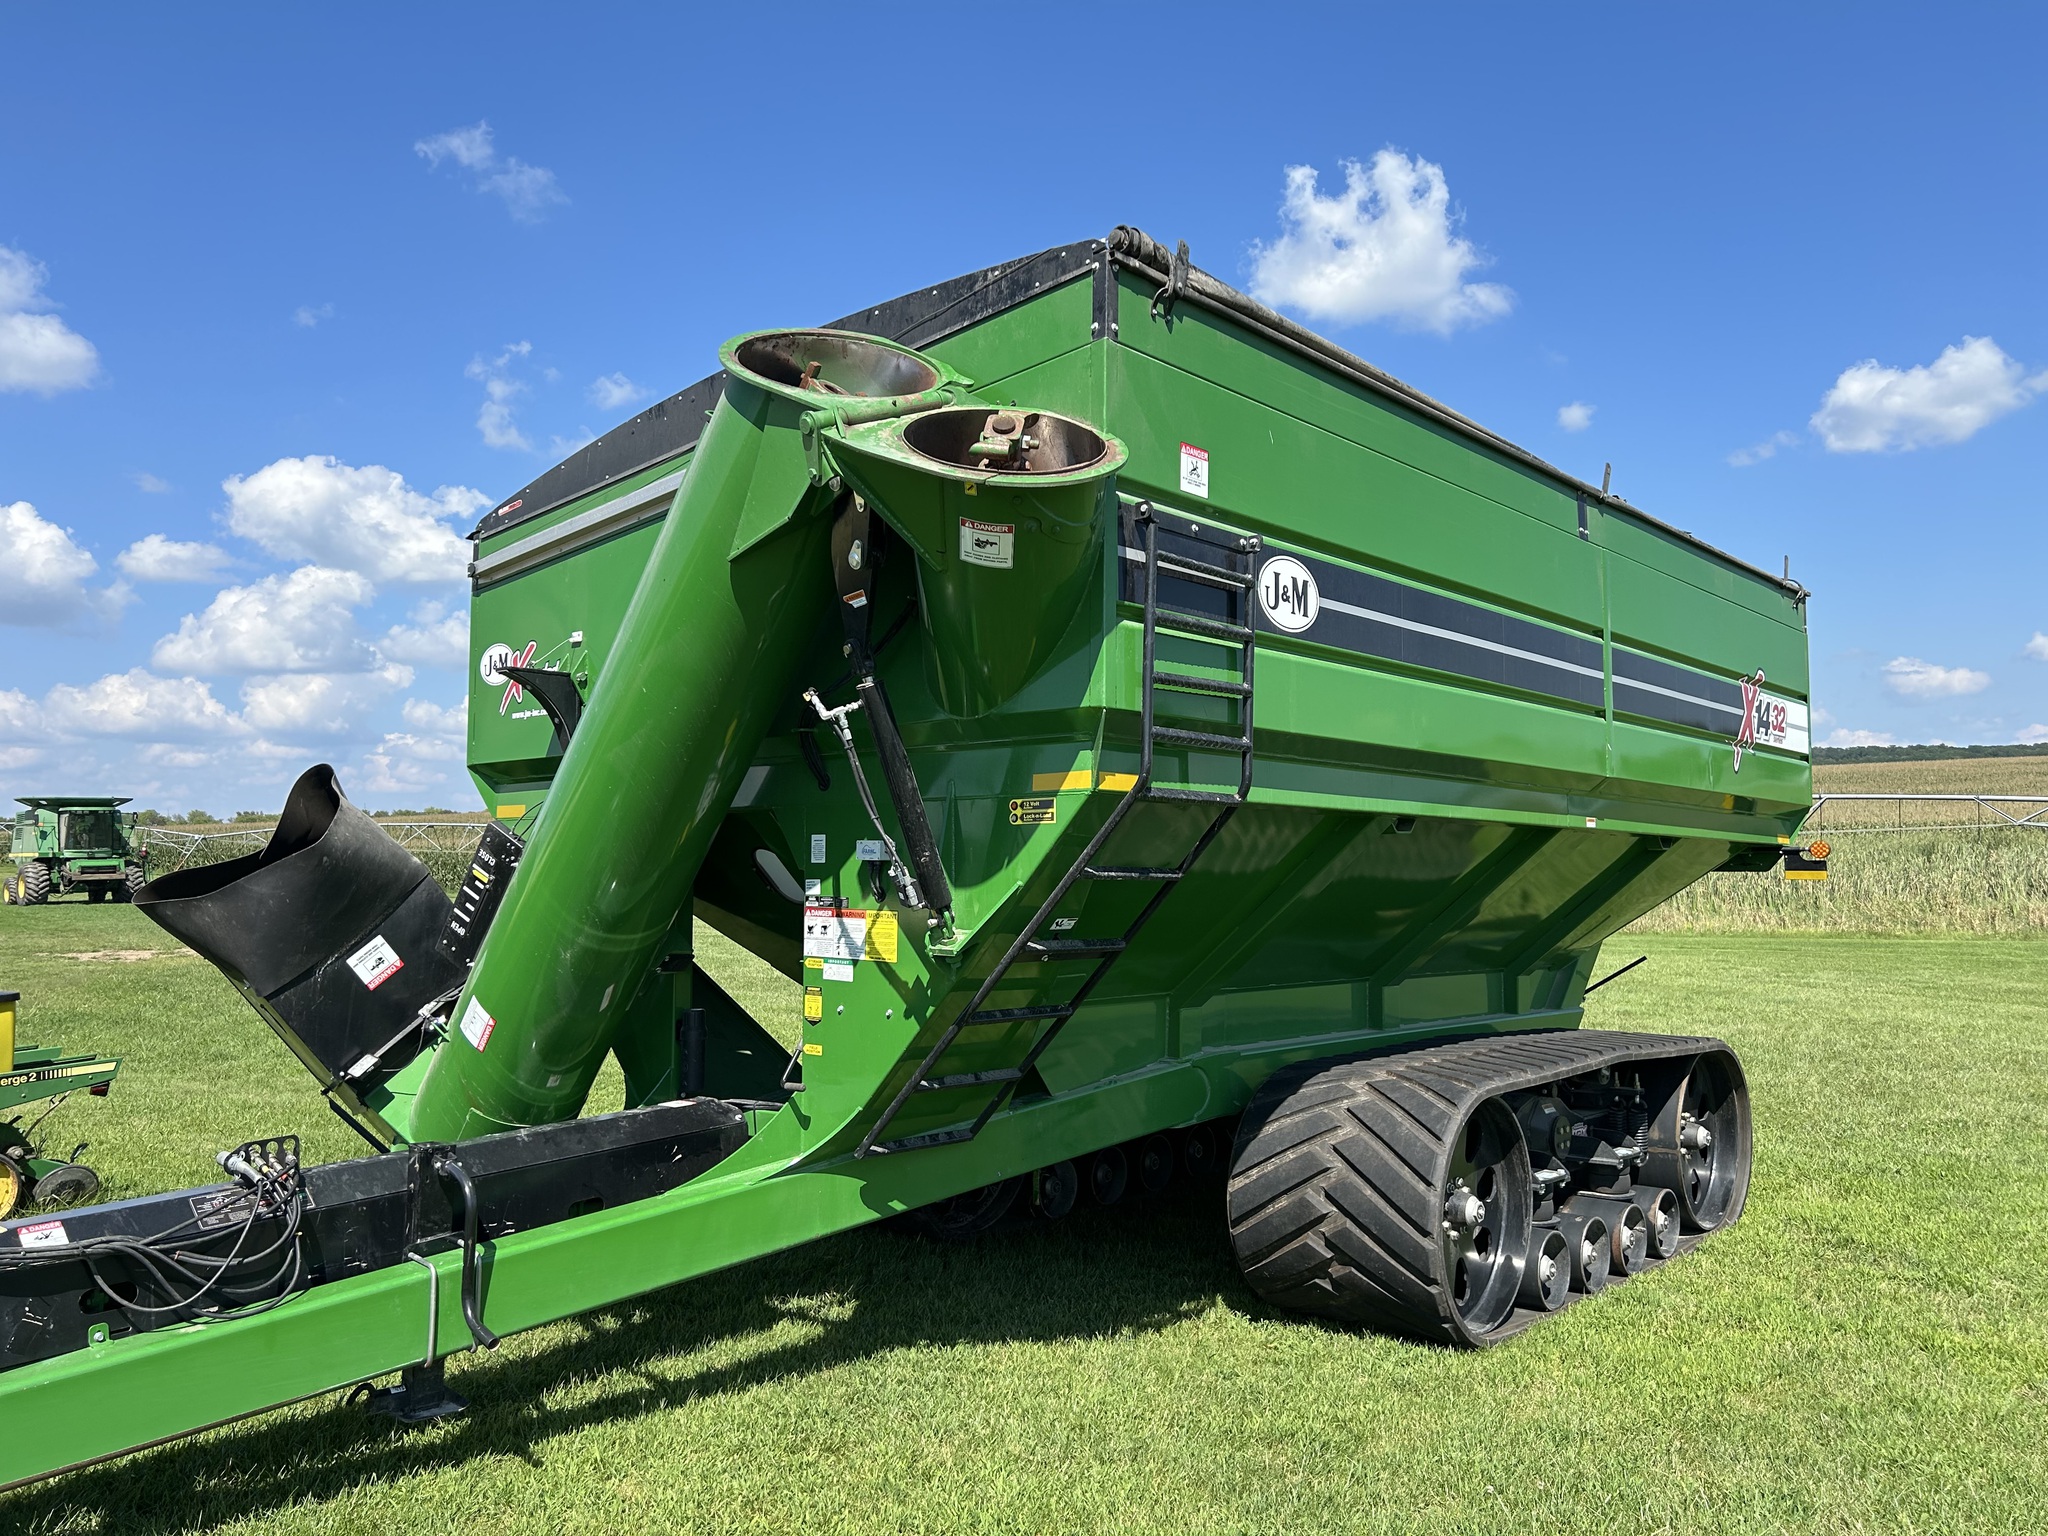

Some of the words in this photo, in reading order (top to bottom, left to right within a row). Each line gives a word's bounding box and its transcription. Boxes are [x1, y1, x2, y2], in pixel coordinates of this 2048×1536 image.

[1185, 446, 1208, 460] DANGER
[974, 523, 1009, 533] DANGER
[1265, 571, 1310, 618] J&M
[478, 849, 496, 866] CLOSE
[811, 909, 833, 917] DANGER
[450, 920, 466, 937] OPEN
[368, 965, 396, 989] DANGER
[477, 1023, 494, 1051] DANGER
[29, 1072, 37, 1082] 2
[29, 1221, 61, 1232] DANGER
